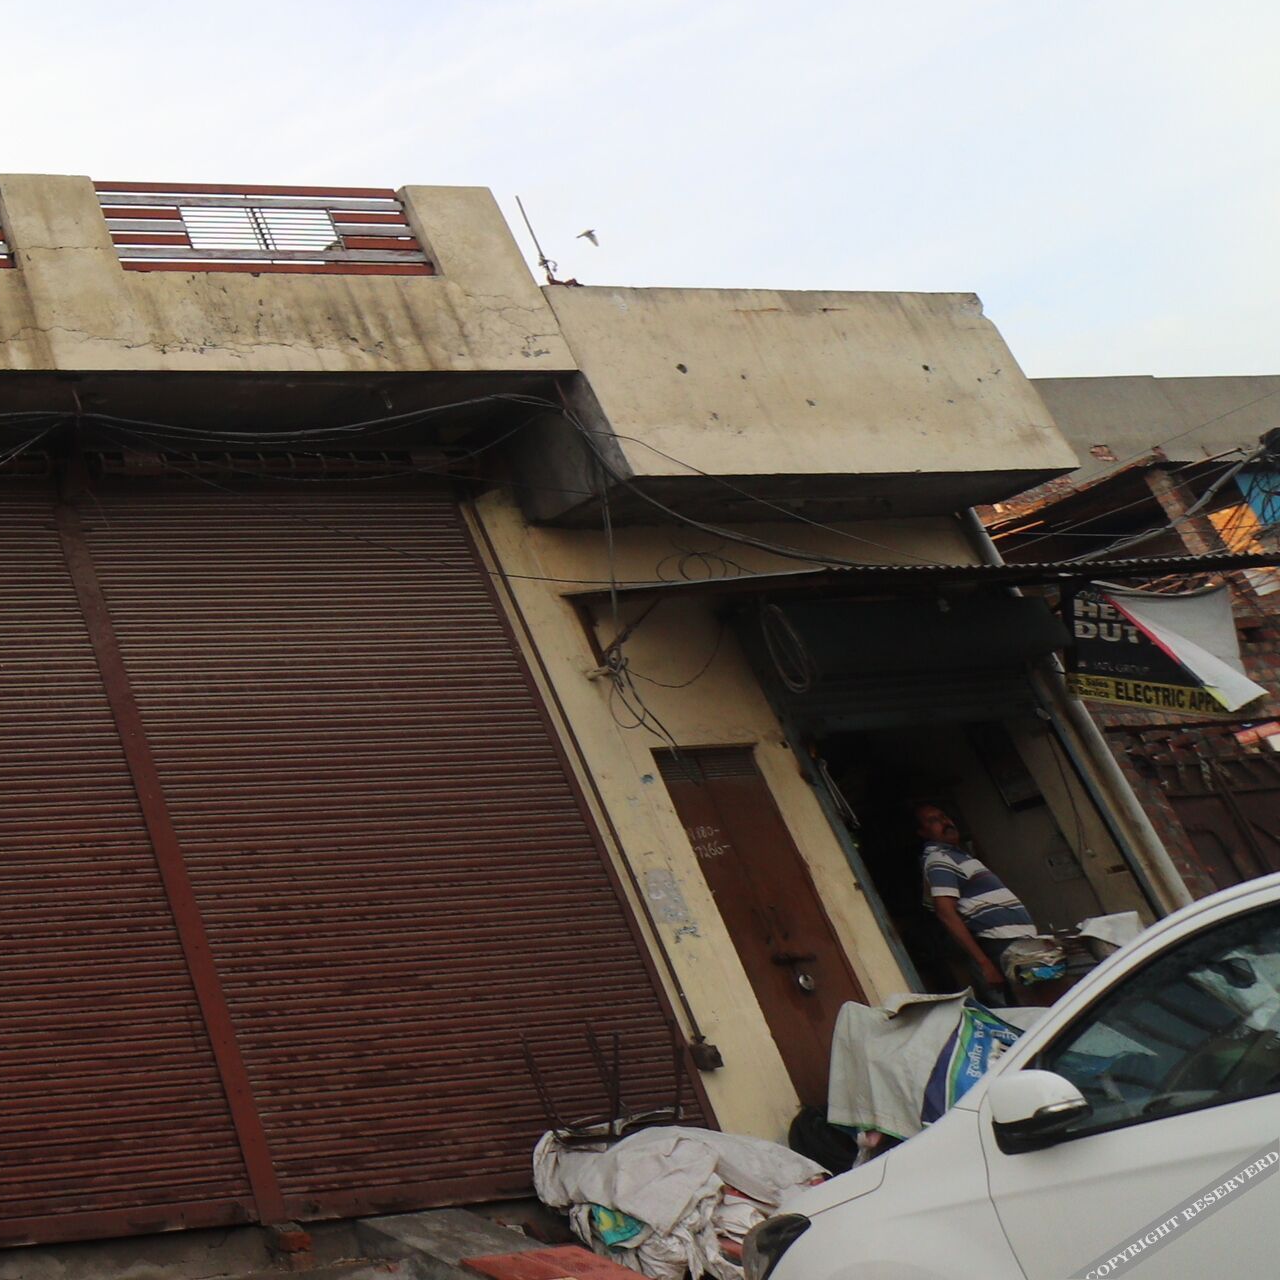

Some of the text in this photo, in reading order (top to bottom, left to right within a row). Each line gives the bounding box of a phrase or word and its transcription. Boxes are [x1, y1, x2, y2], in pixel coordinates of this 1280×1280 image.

[1074, 599, 1126, 620] HE
[1074, 620, 1143, 644] DUT
[1115, 681, 1226, 712] ELECTRIC APPL
